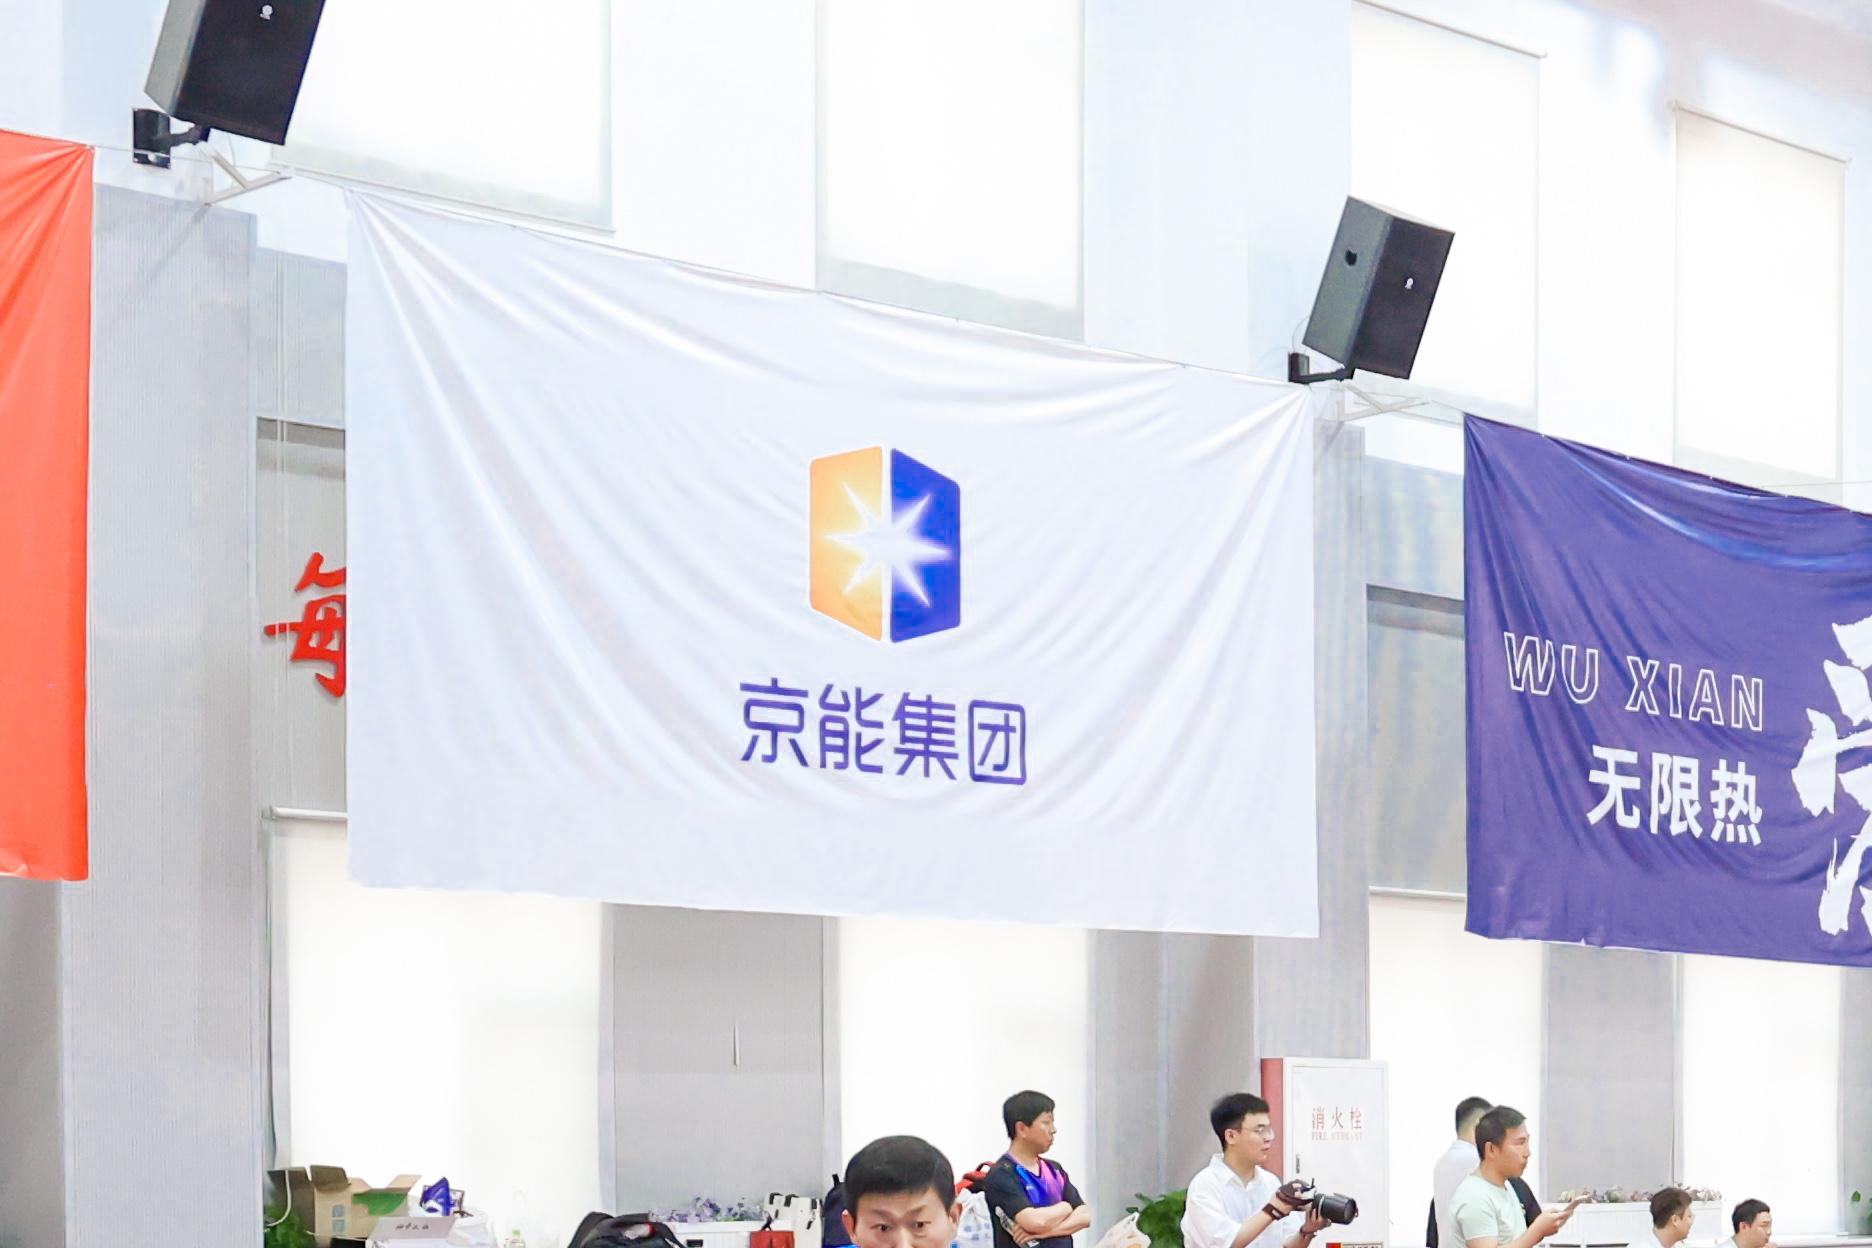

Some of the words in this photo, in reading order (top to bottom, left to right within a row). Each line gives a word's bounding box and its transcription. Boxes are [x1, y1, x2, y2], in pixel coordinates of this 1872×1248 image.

[740, 677, 1028, 785] 京能集团
[1503, 631, 1599, 705] WU
[1625, 654, 1764, 732] XIAN
[1586, 744, 1763, 847] 无限热
[1311, 1106, 1362, 1130] 消火栓
